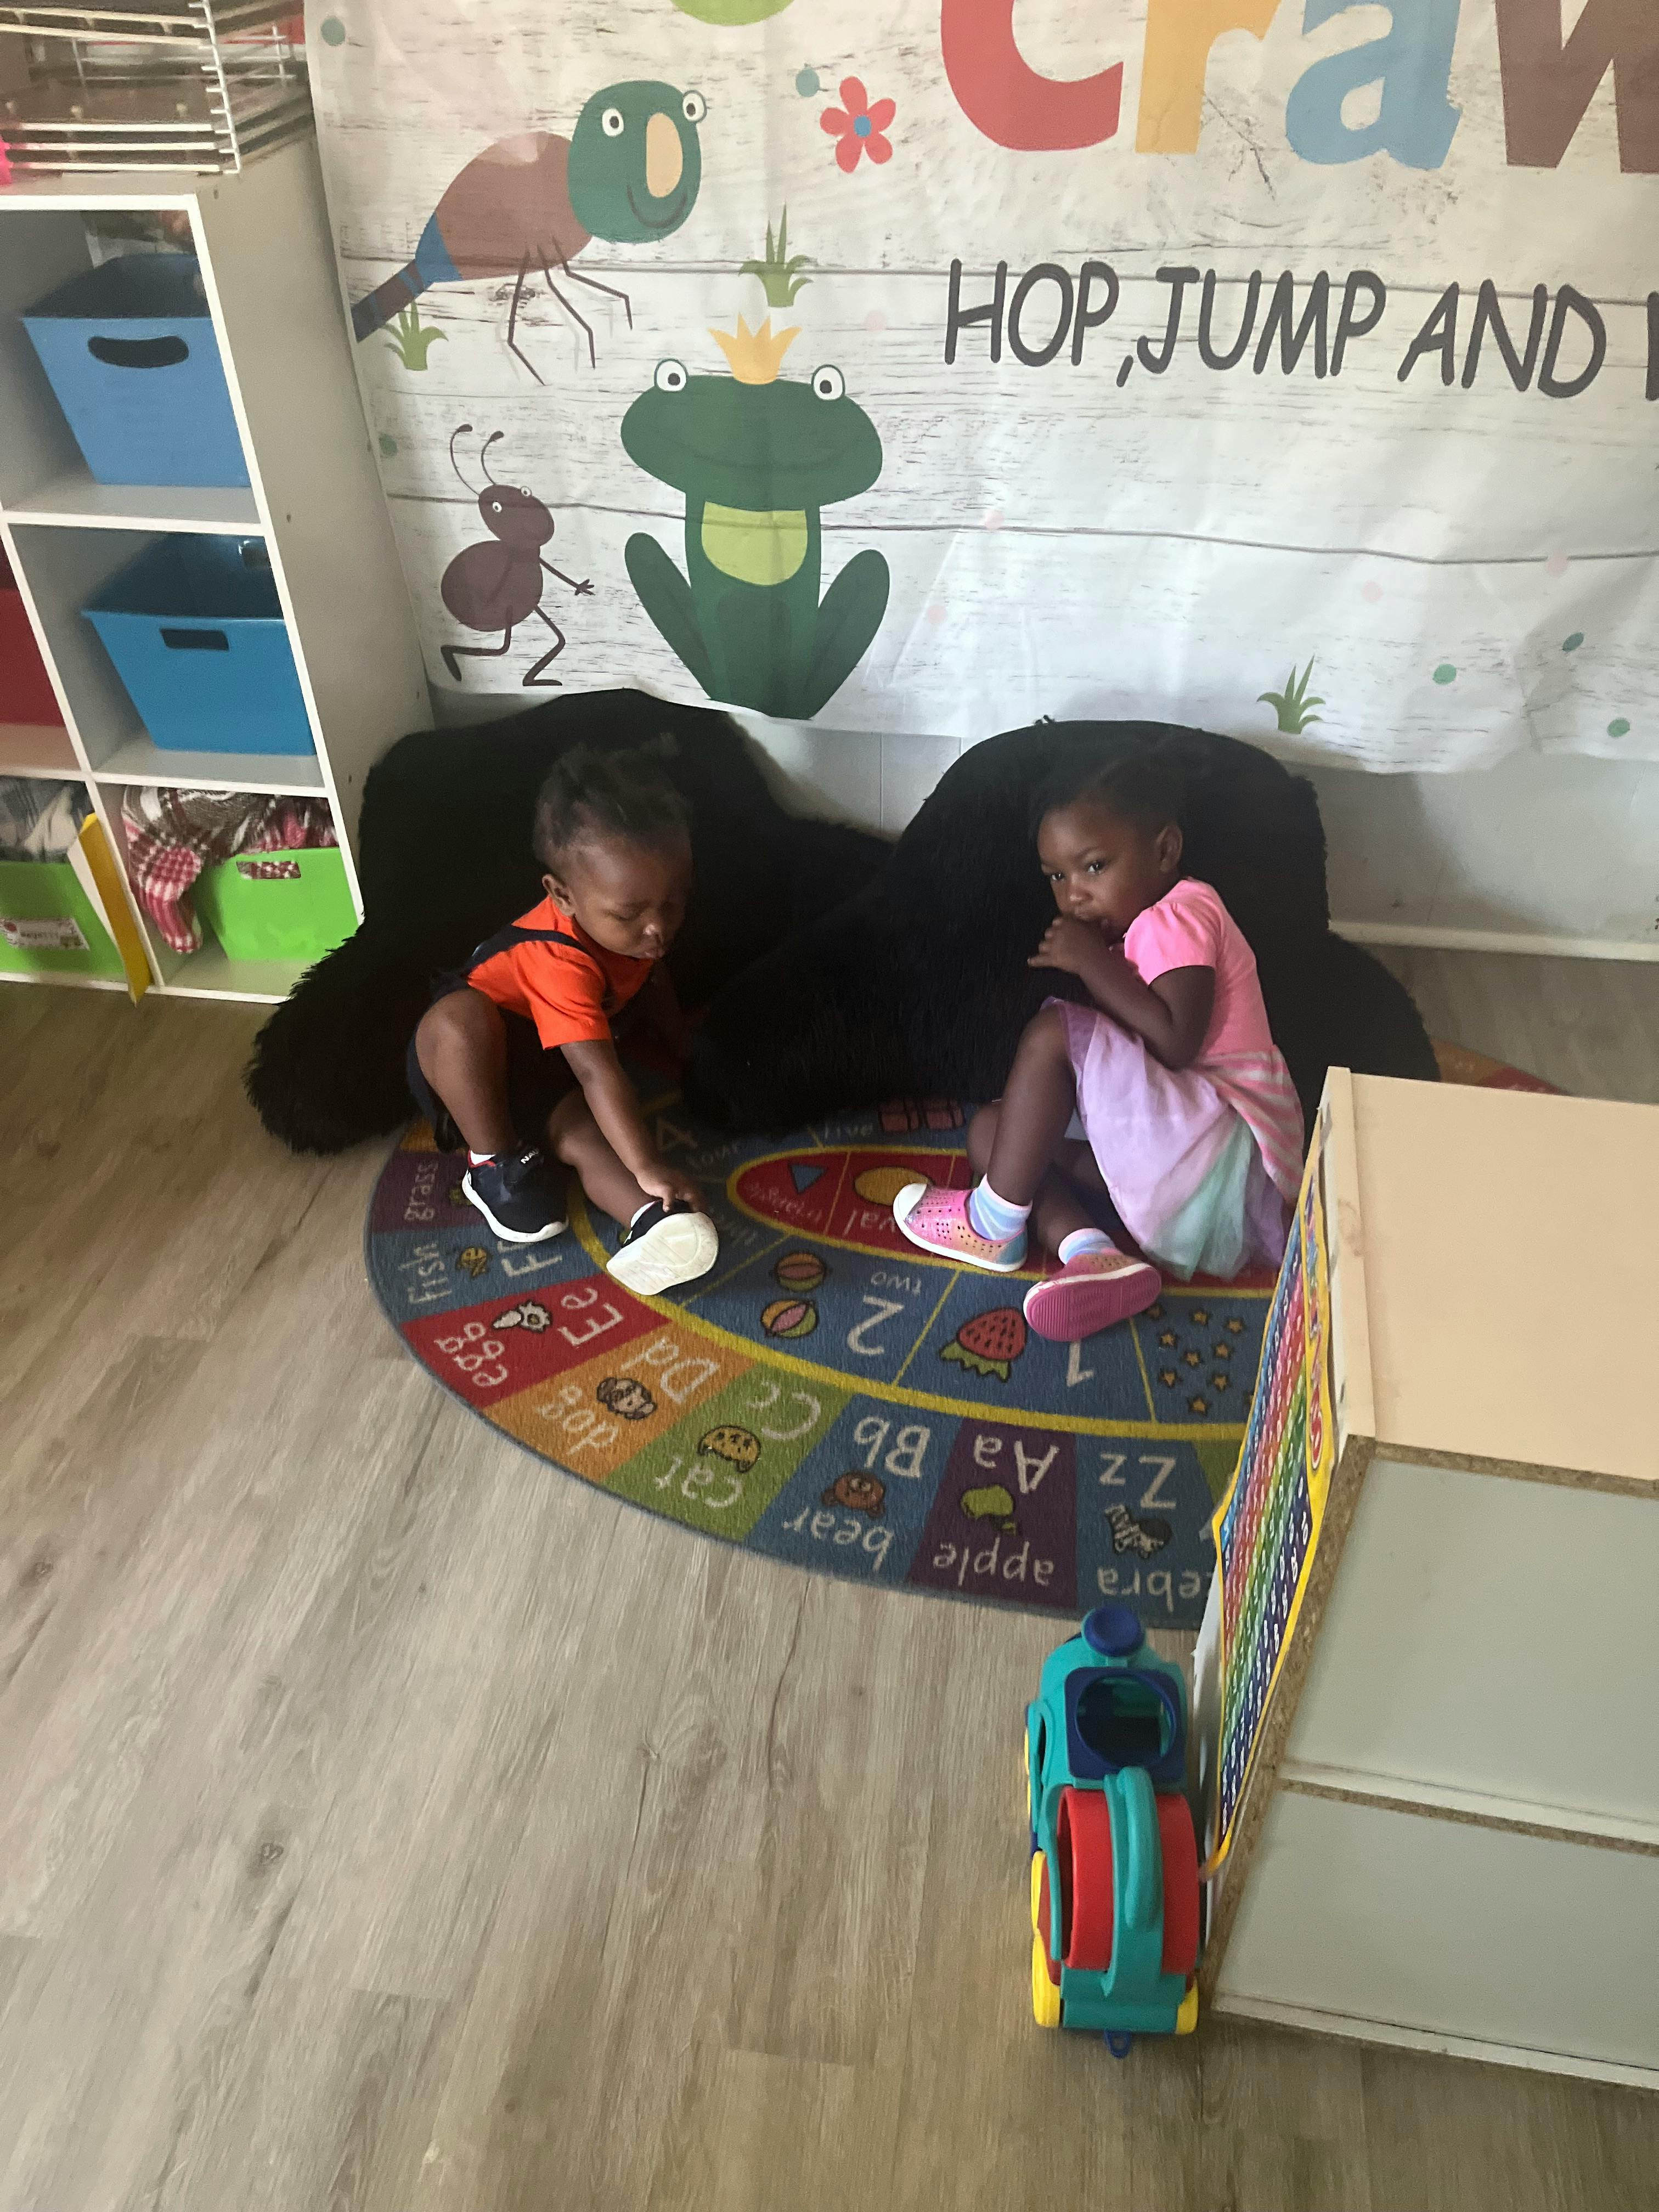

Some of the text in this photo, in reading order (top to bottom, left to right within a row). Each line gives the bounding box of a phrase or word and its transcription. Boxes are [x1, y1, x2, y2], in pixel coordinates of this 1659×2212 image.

[1397, 279, 1608, 399] AND
[404, 1163, 438, 1221] grass
[843, 1209, 896, 1236] val
[870, 1271, 922, 1296] two
[433, 1322, 509, 1386] egg
[847, 1295, 905, 1356] 2
[620, 1336, 720, 1404] Dd
[1066, 1340, 1095, 1387] 1
[537, 1385, 619, 1455] dog
[744, 1378, 822, 1441] Cc
[853, 1415, 931, 1479] Bb
[973, 1434, 1060, 1494] Aa
[654, 1455, 742, 1508] cat
[1099, 1453, 1176, 1509] Zz
[782, 1506, 894, 1573] bear
[933, 1537, 1055, 1587] apple
[1098, 1567, 1211, 1613] ebra
